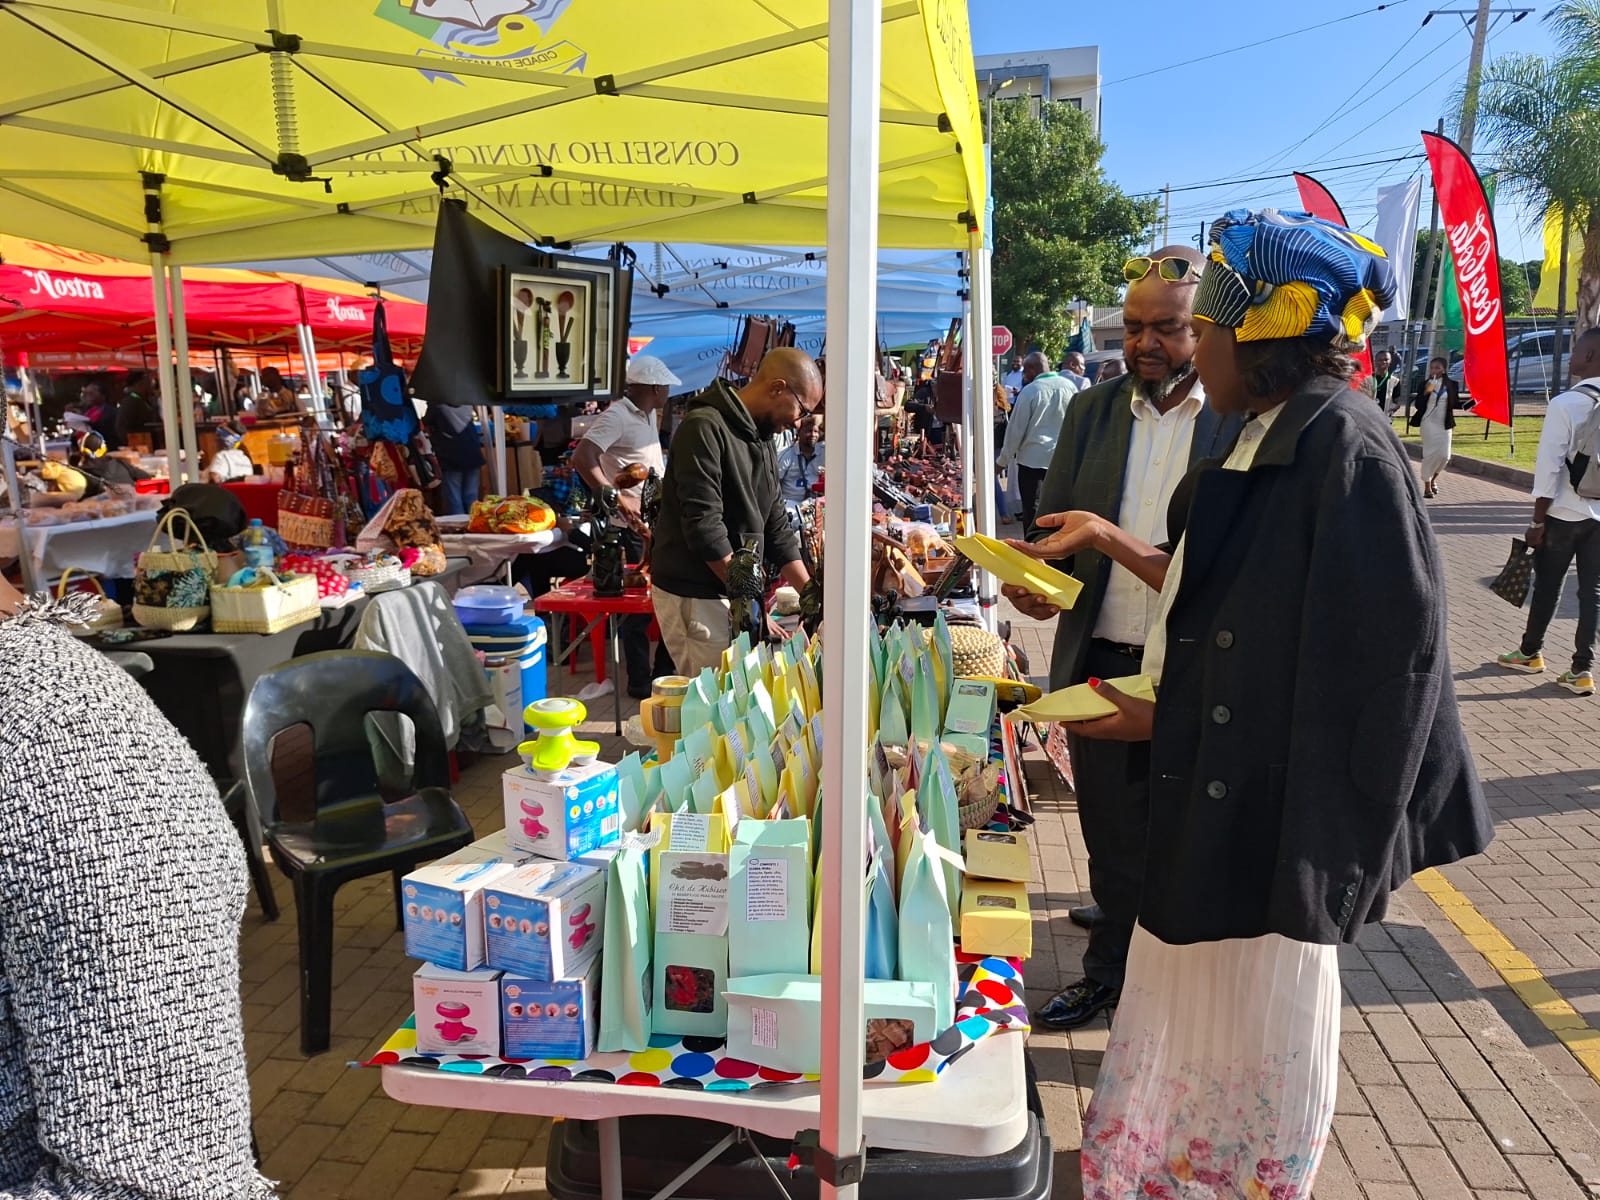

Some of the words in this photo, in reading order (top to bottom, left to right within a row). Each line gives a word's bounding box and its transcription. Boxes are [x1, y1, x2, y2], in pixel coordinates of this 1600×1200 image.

[22, 270, 105, 299] Nostra
[326, 296, 366, 321] Nostra
[992, 335, 1009, 347] TOP
